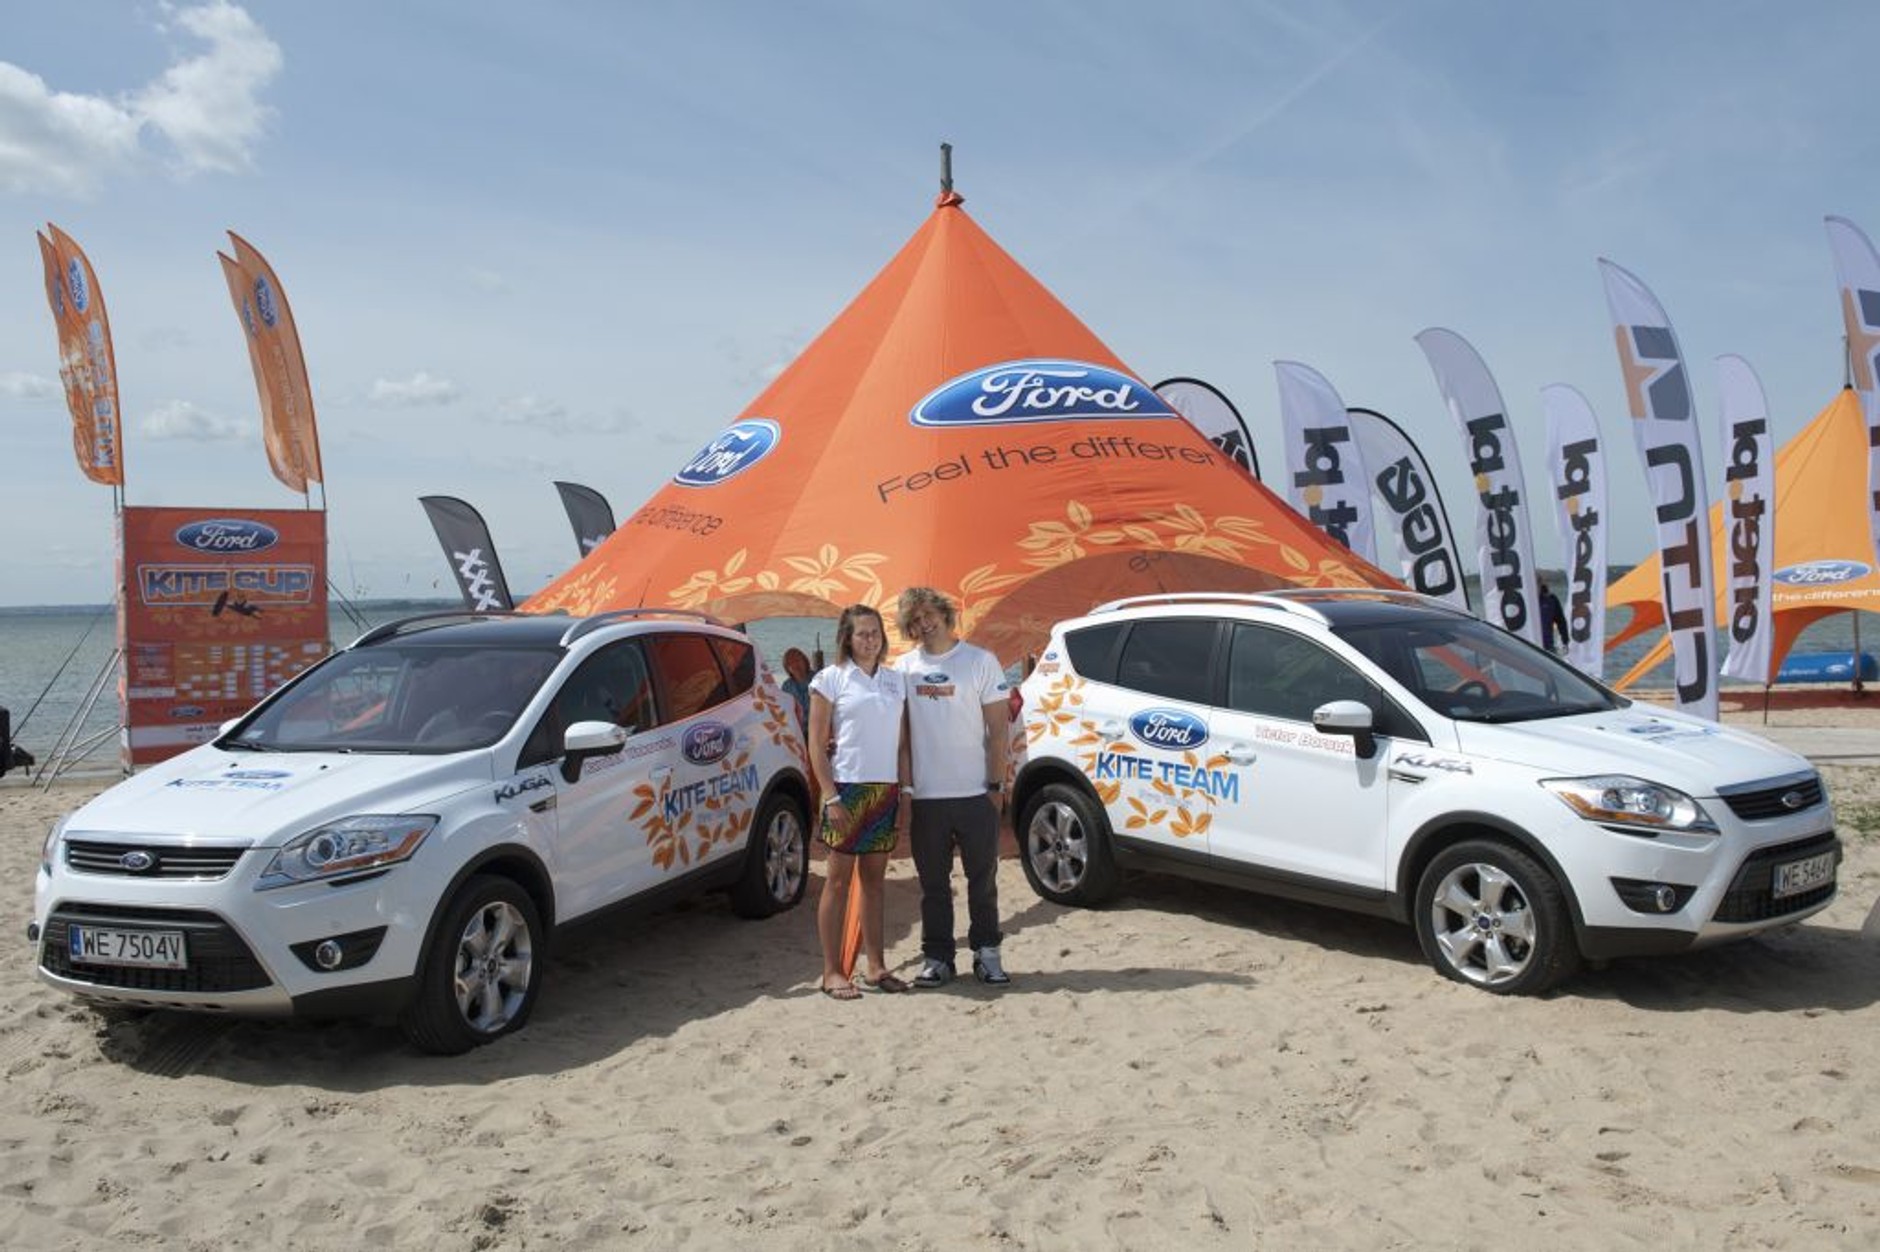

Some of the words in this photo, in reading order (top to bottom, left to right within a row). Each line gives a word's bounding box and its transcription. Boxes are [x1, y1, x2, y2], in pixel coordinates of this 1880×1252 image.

[972, 369, 1139, 417] Ford
[877, 454, 973, 504] Feel
[981, 447, 1057, 470] the
[195, 523, 260, 548] Ford
[145, 569, 231, 597] KITE
[232, 568, 310, 595] CUP
[1789, 563, 1852, 583] Ford
[1143, 712, 1192, 744] Ford
[664, 781, 706, 823] KITE
[708, 763, 760, 798] TEAM
[1096, 751, 1154, 780] KITE
[1157, 761, 1240, 804] TEAM
[83, 930, 110, 956] WE
[116, 933, 180, 960] 7504V
